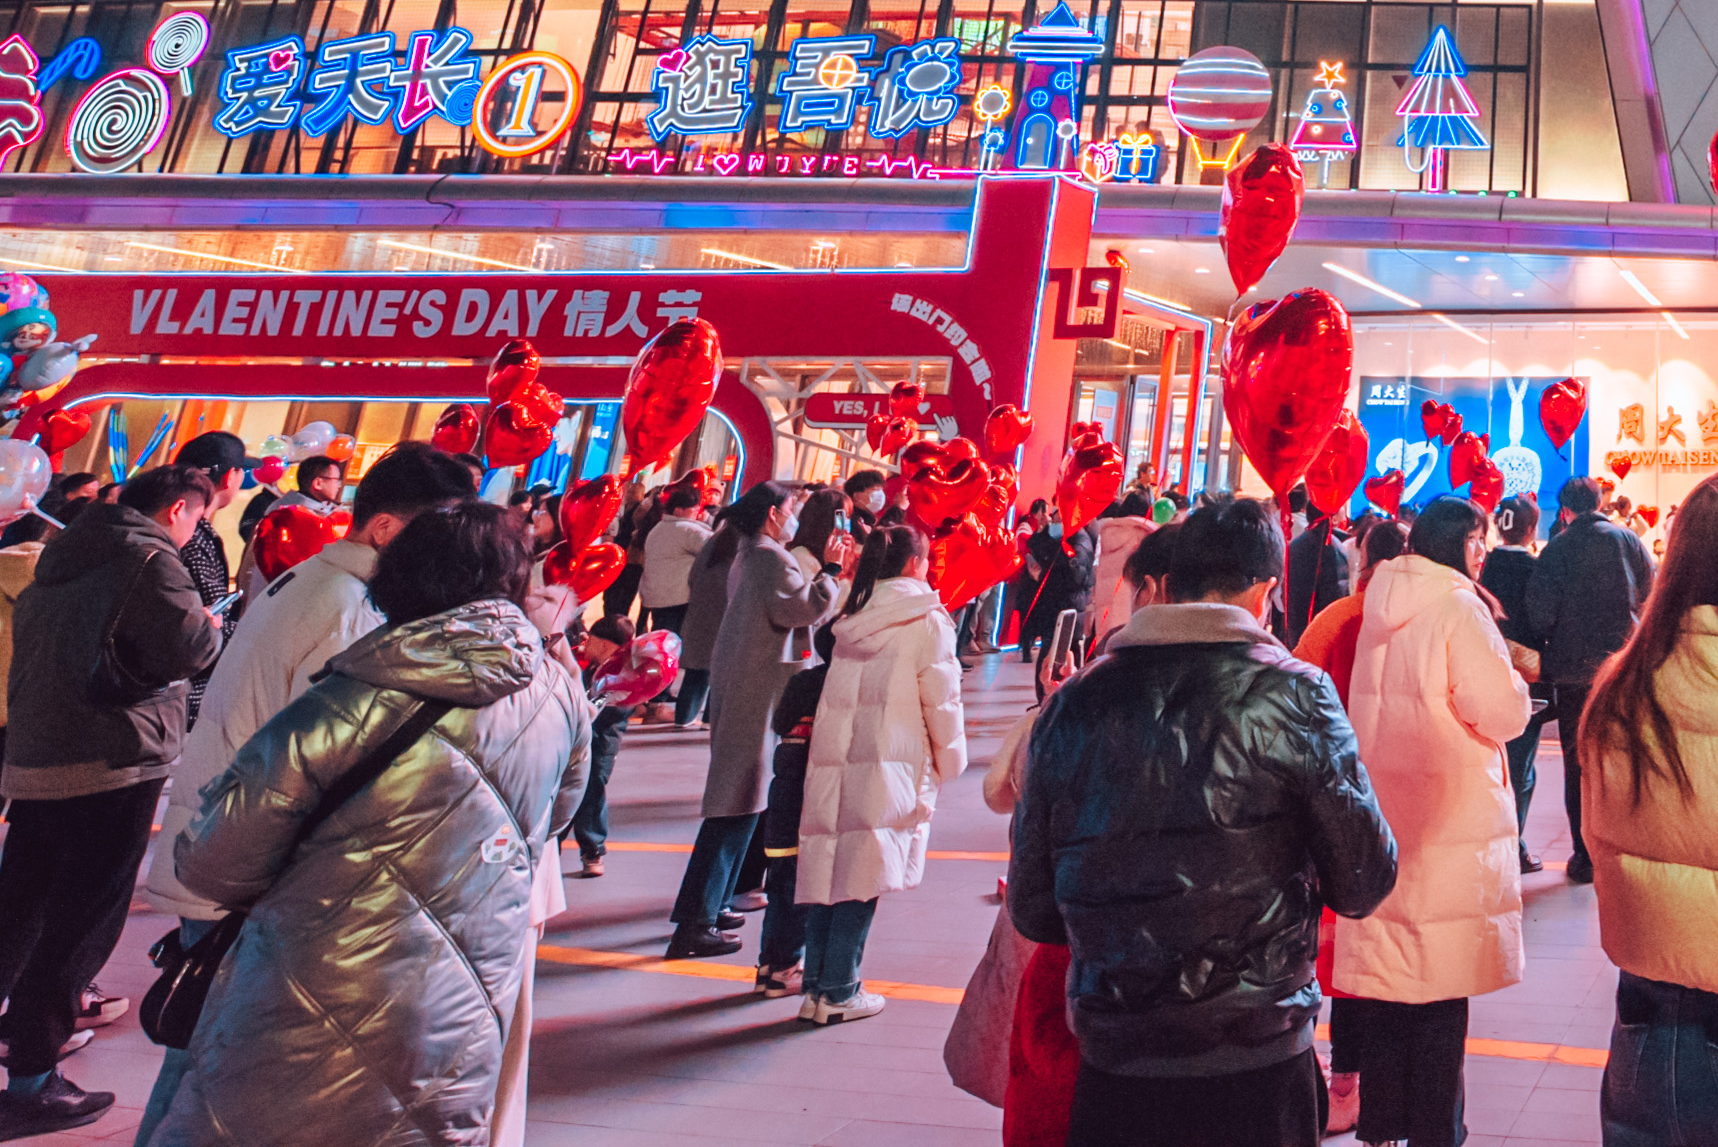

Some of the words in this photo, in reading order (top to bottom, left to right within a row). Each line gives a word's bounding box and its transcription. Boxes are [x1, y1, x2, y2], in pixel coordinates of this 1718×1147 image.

[213, 26, 483, 138] 爱天长
[129, 288, 447, 337] VLAENTINE'S
[451, 289, 558, 337] DAY
[833, 400, 868, 418] YES,
